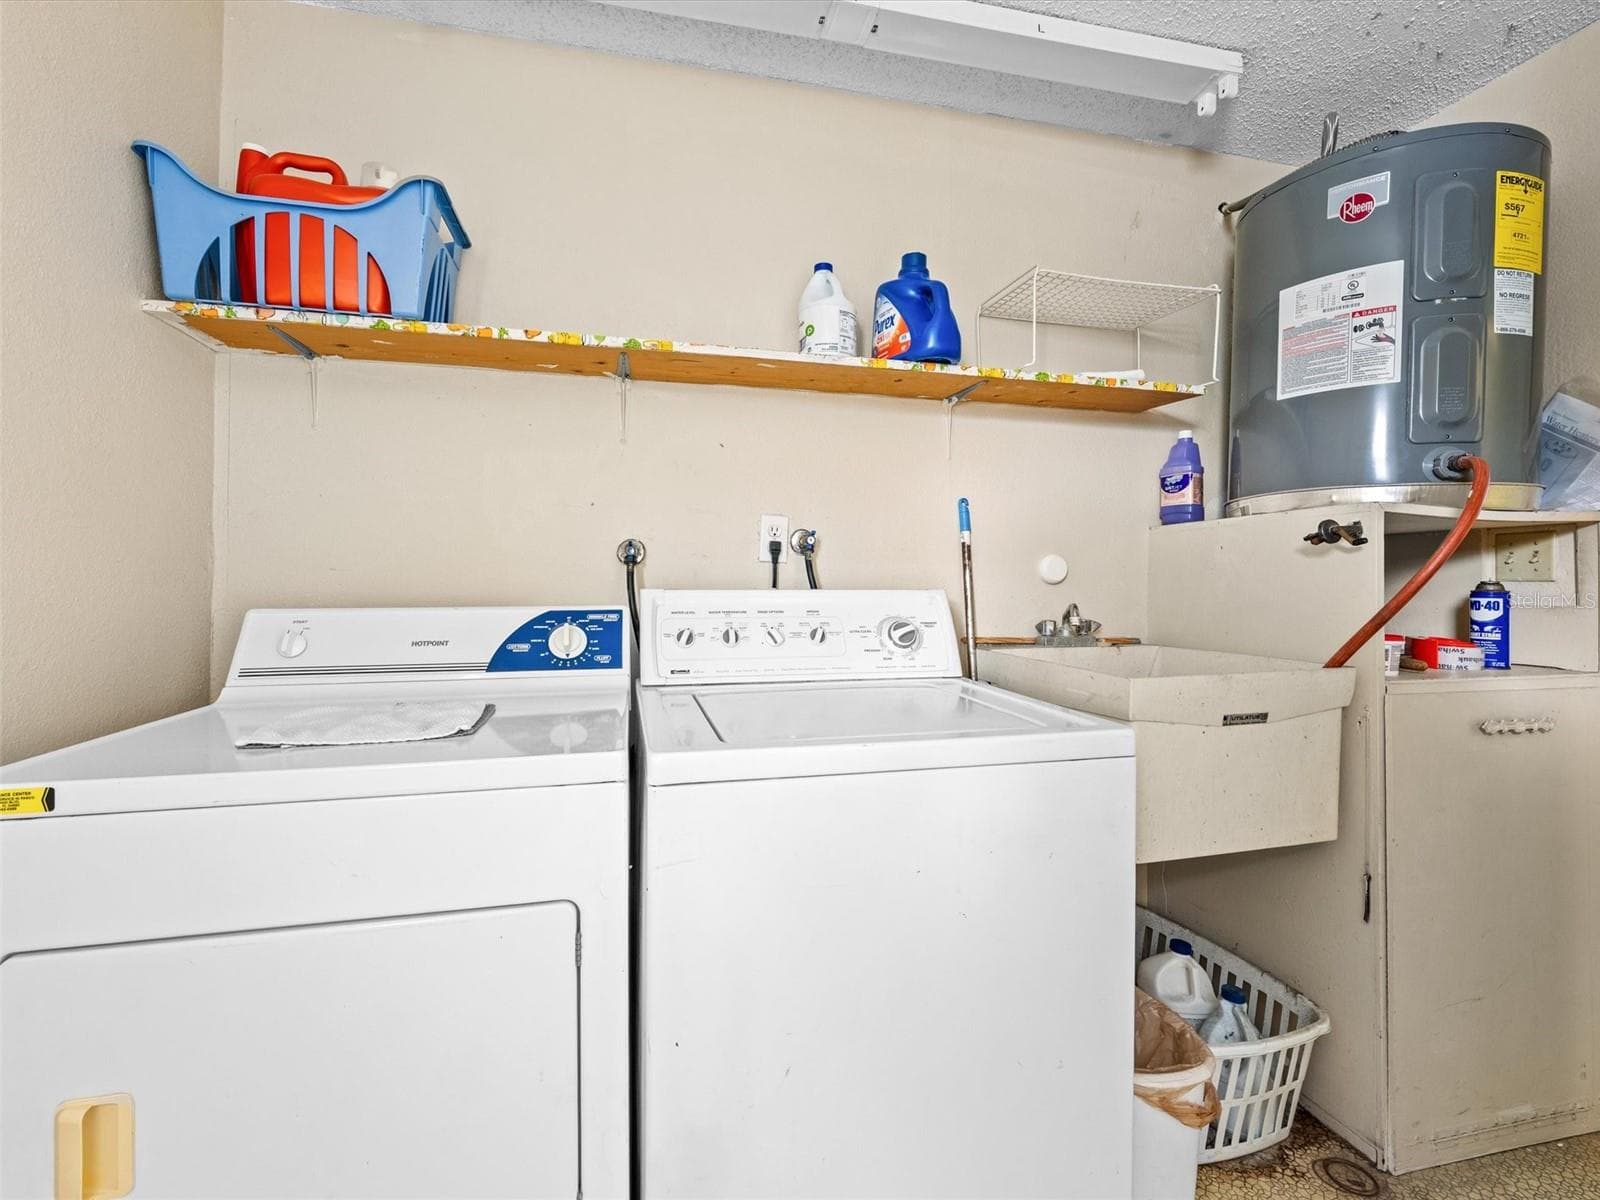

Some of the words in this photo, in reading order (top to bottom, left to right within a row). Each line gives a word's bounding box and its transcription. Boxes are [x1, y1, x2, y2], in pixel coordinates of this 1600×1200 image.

[1342, 194, 1374, 220] Rheem
[1516, 271, 1533, 279] RETURN
[1361, 306, 1395, 316] DANGER
[874, 314, 896, 334] Purex
[410, 640, 450, 648] HOTPOINT
